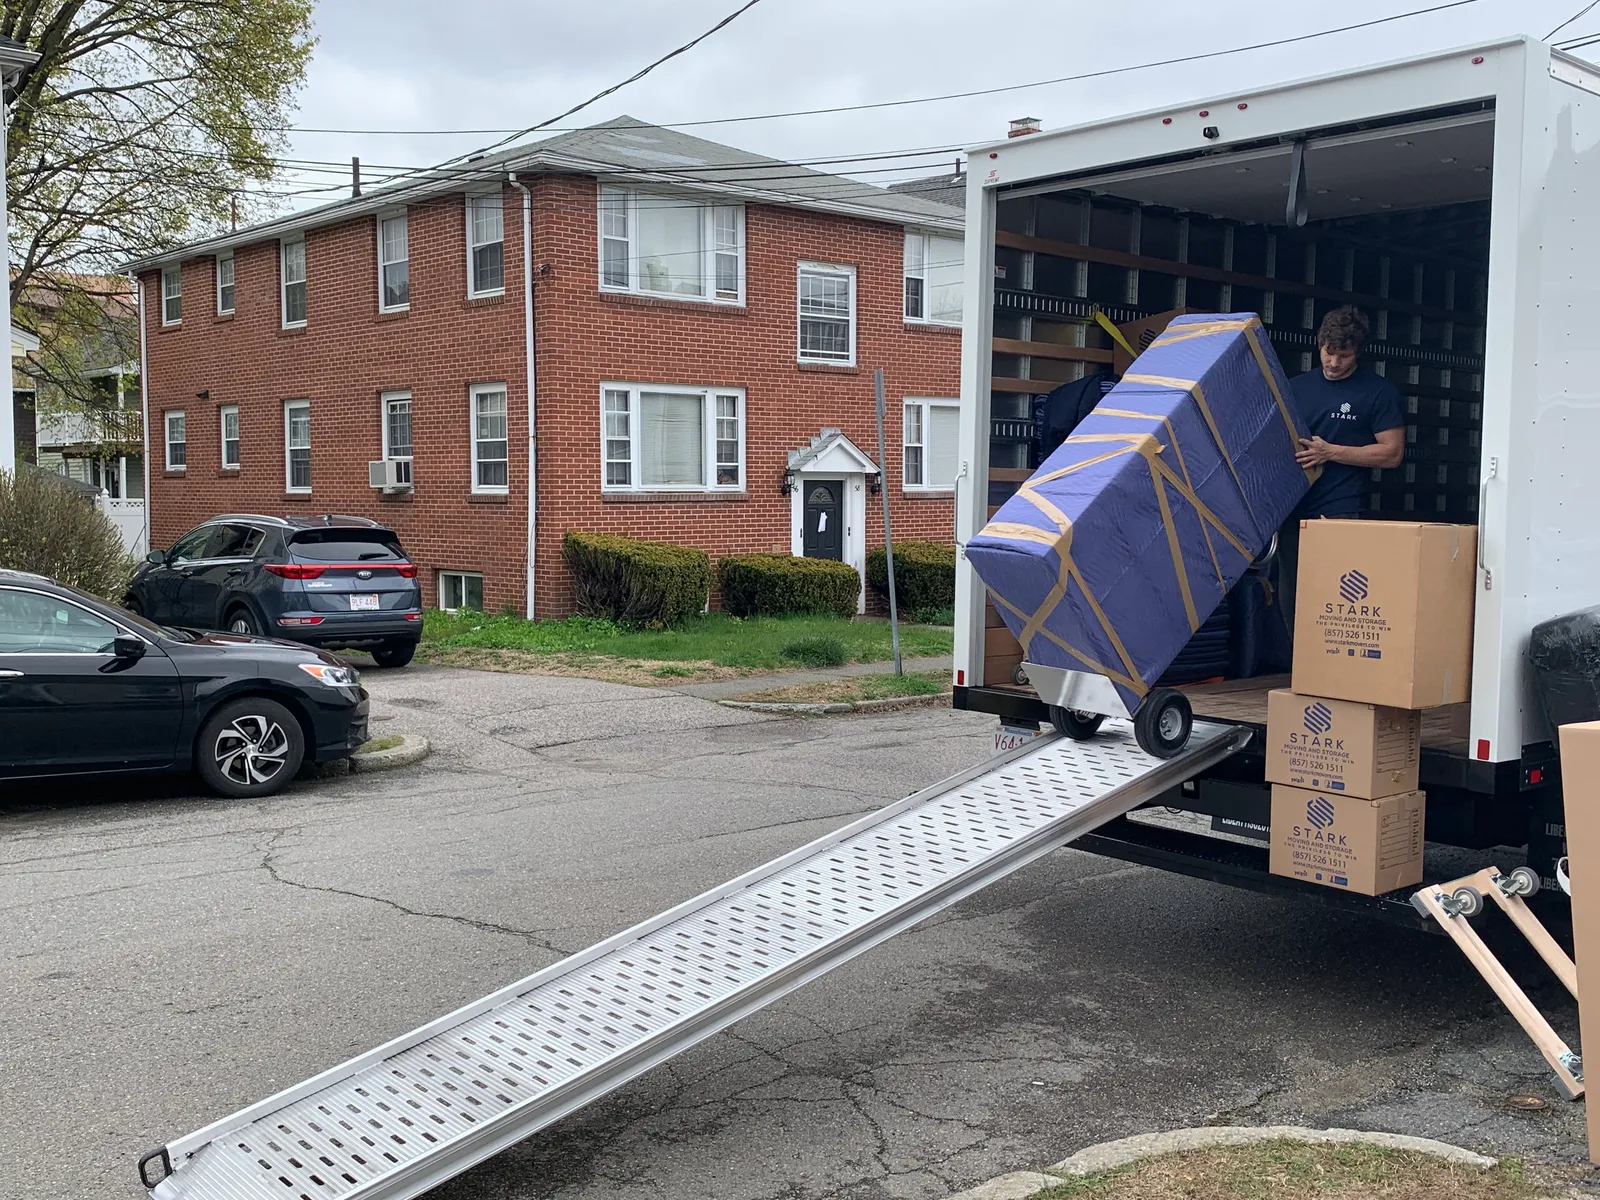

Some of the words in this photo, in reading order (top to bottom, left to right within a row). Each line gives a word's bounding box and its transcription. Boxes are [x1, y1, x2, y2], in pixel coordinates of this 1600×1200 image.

[1331, 412, 1357, 420] STARK
[1325, 603, 1381, 617] STARK
[1358, 618, 1387, 626] STORAGE
[1324, 628, 1343, 638] (857)
[1345, 630, 1360, 639] 526
[1362, 632, 1380, 641] 1511
[1324, 639, 1380, 649] www.starkmovers.com
[1290, 732, 1344, 750] STARK
[1284, 743, 1307, 752] MOVING
[1321, 749, 1350, 758] STORAGE
[1289, 757, 1308, 768] (857)
[1309, 760, 1324, 770] 526
[1326, 763, 1344, 773] 1511
[1289, 768, 1344, 780] www.starkmovers.com
[1293, 826, 1347, 846] STARK
[1545, 823, 1566, 837] LIBE
[1287, 836, 1310, 846] MOVING
[1324, 843, 1353, 854] STORAGE
[1292, 850, 1311, 861] (857)
[1312, 854, 1327, 864] 526
[1329, 857, 1347, 868] 1511
